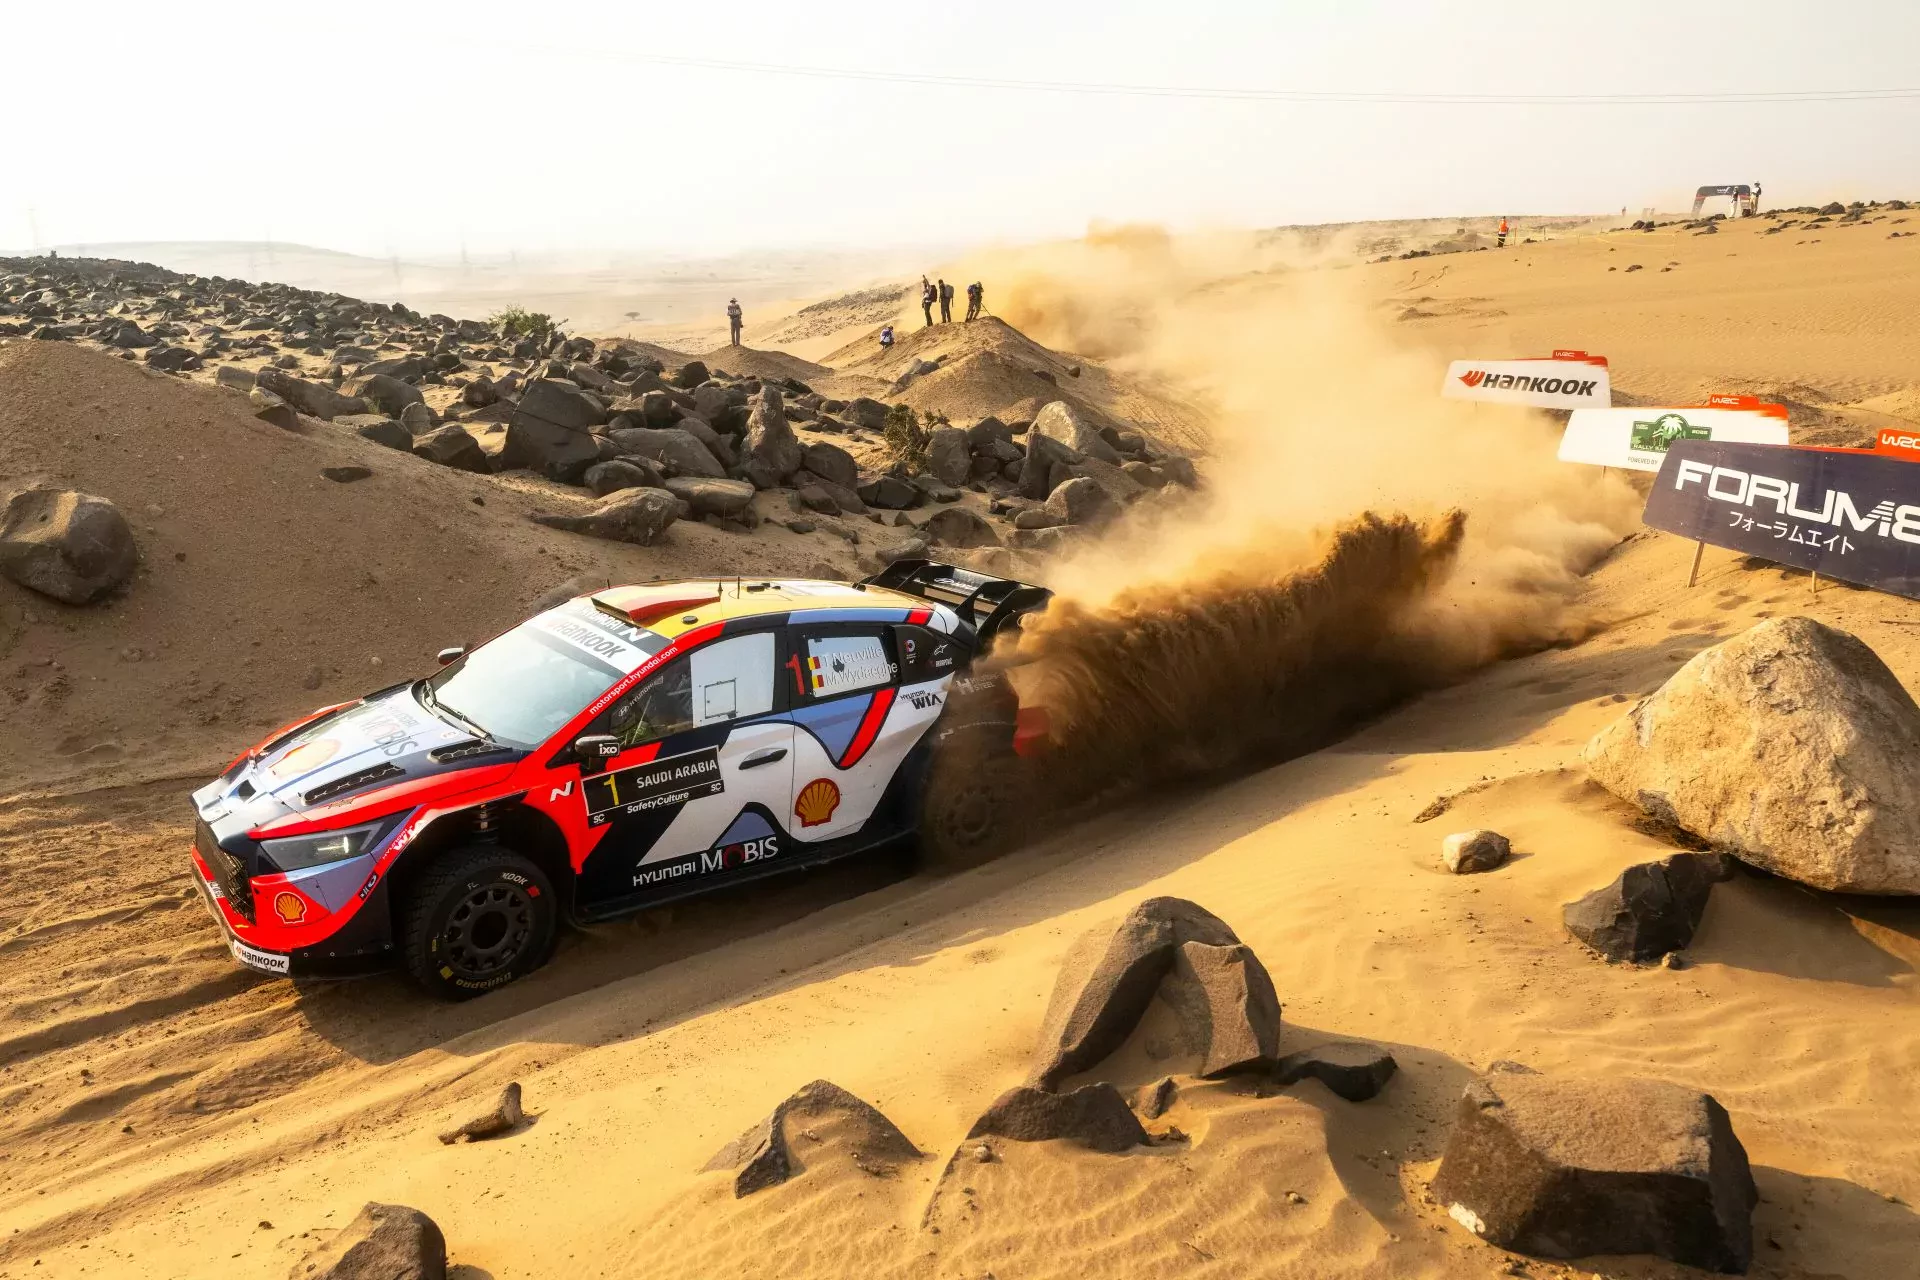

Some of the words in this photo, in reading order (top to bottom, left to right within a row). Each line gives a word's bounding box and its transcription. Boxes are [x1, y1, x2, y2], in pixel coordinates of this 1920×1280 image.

[1711, 396, 1740, 405] WRC
[1675, 459, 1920, 545] FORUM8
[1729, 511, 1855, 555] フォーラムエイト
[589, 646, 678, 714] motorsport.hyundai.com
[785, 653, 805, 696] 1
[900, 689, 926, 700] HYUNDAI
[599, 744, 618, 755] ixo
[603, 774, 620, 806] 1
[636, 770, 672, 789] SAUDI
[675, 759, 718, 779] ARABIA
[627, 791, 689, 814] SafetyCulture
[632, 861, 696, 887] HYUNDAI
[700, 836, 779, 874] MOBIS
